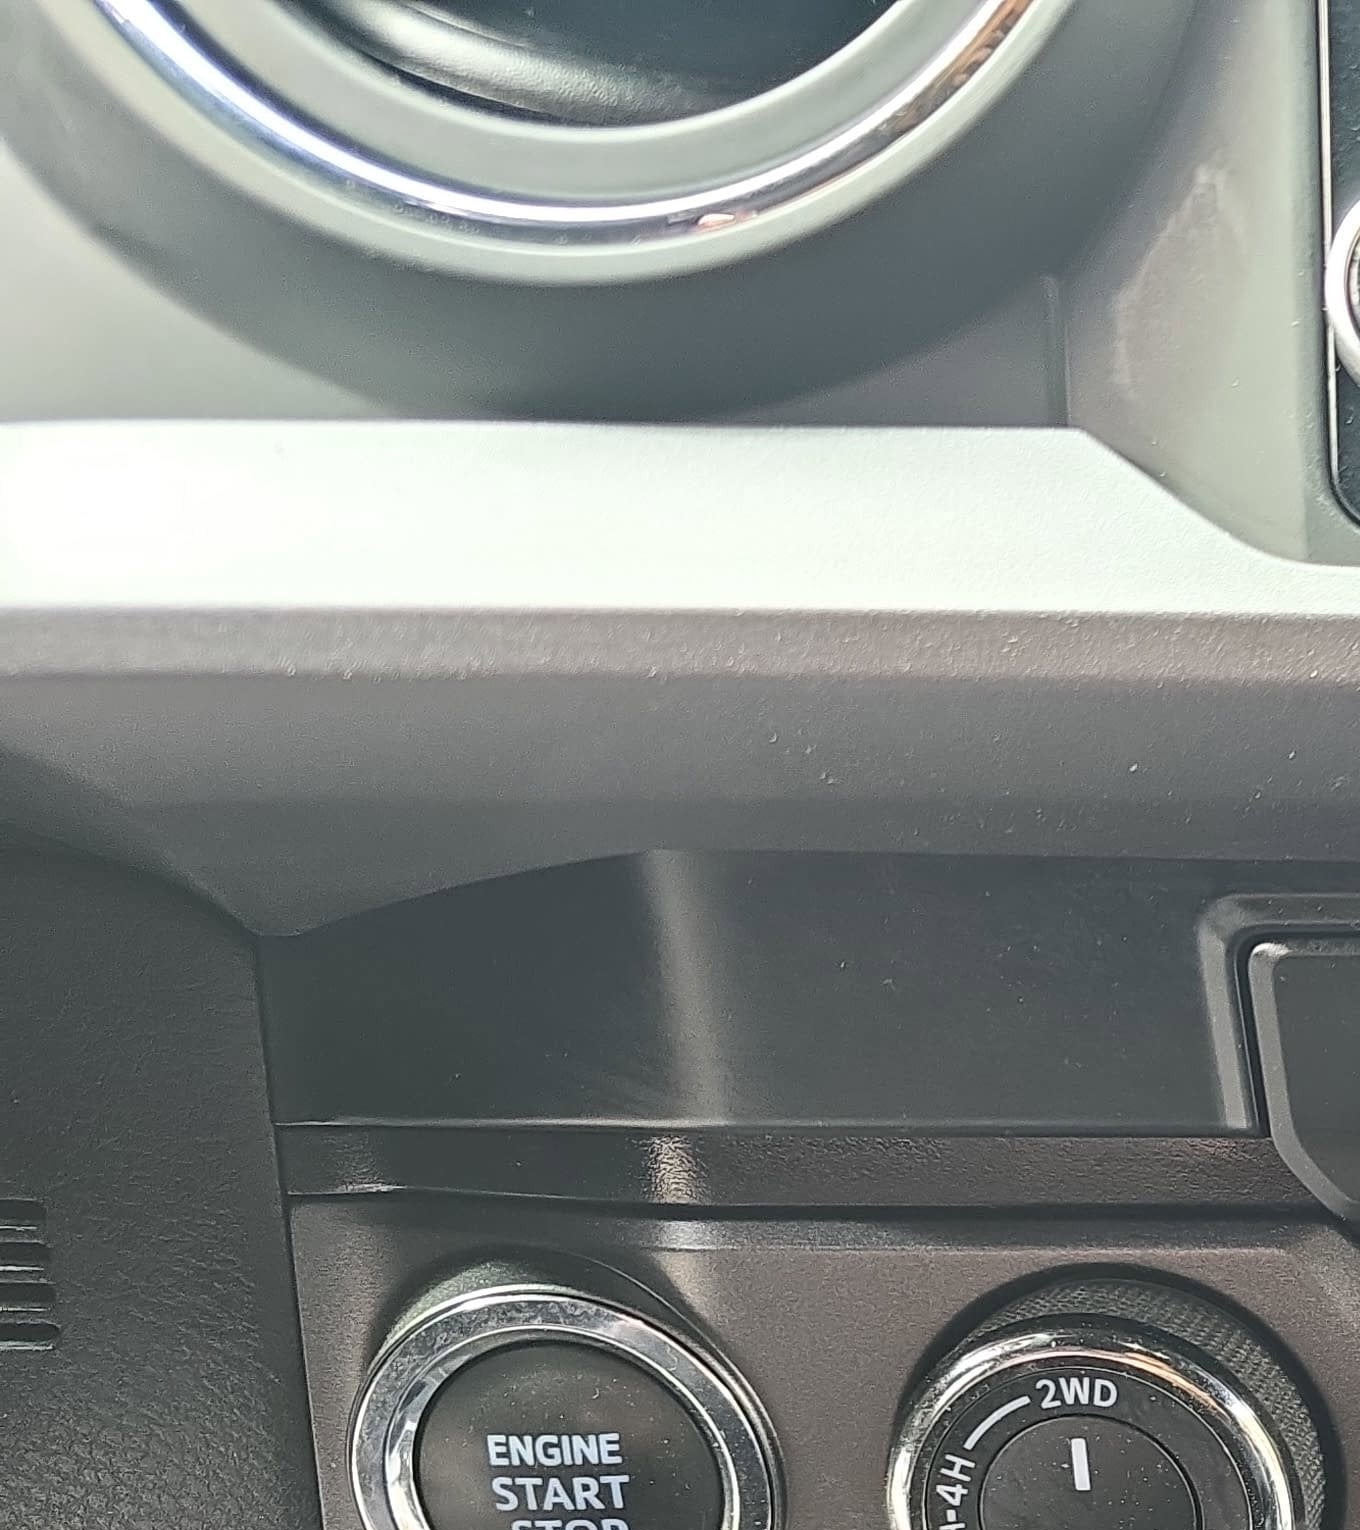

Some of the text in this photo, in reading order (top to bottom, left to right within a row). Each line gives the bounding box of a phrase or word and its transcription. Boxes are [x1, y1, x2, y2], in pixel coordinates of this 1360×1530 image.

[1036, 1377, 1117, 1408] 2WD
[487, 1433, 622, 1466] ENGINE
[492, 1475, 629, 1510] START
